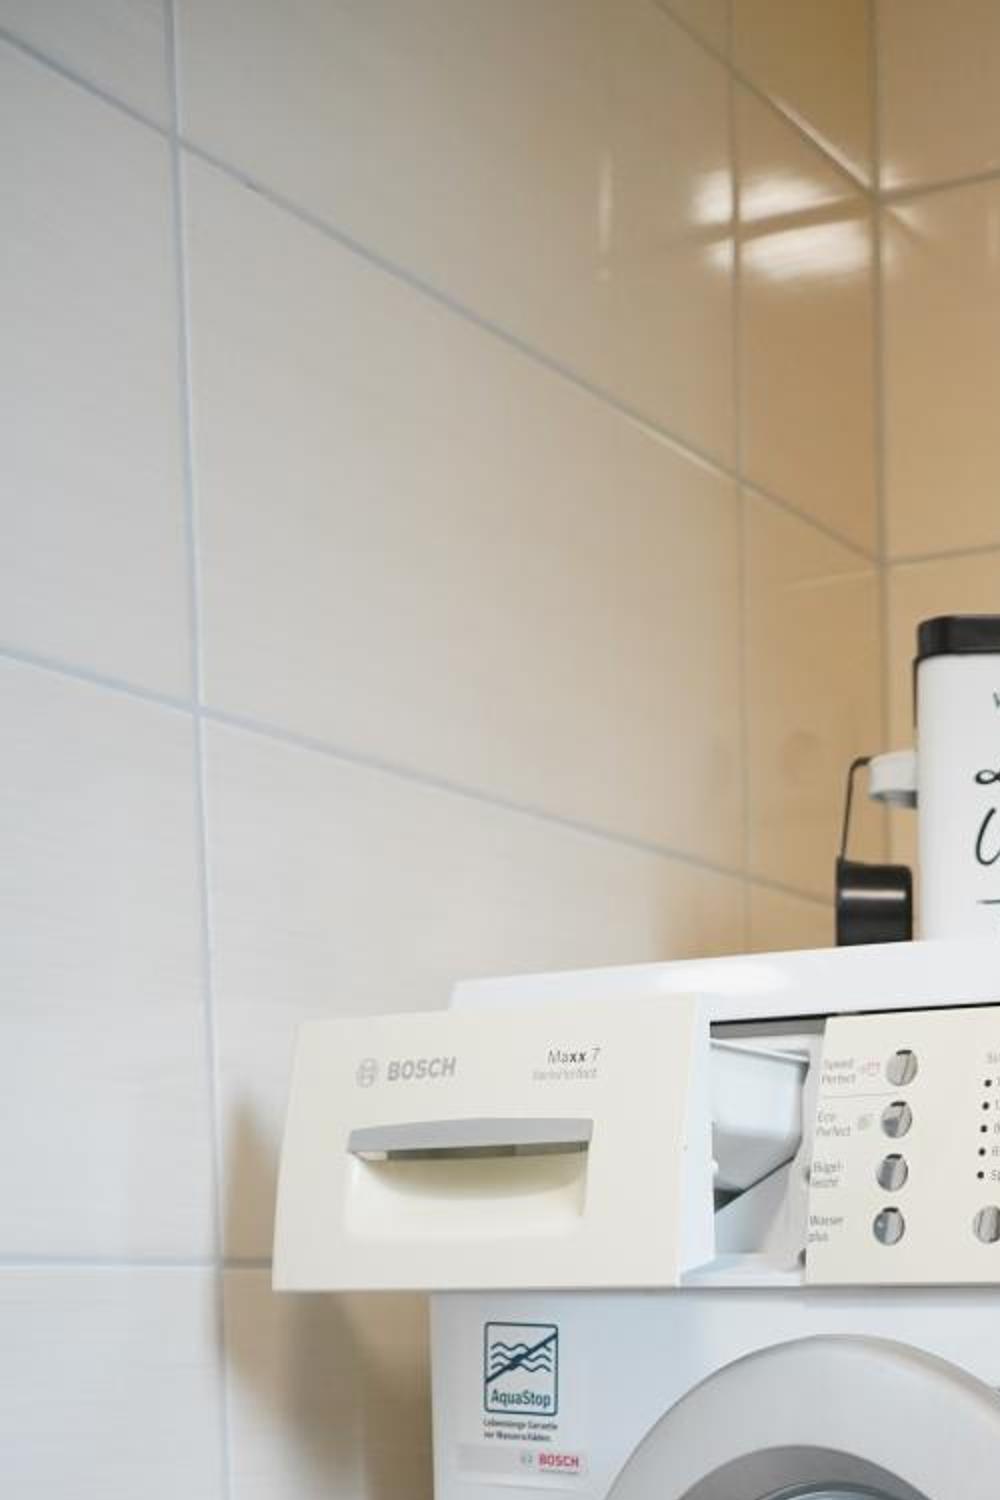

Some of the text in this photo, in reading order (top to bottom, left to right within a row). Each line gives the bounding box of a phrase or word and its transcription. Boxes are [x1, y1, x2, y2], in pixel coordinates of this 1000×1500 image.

[547, 1050, 586, 1064] Maxx
[387, 1056, 457, 1081] BOSCH
[491, 1389, 551, 1408] AquaStop
[539, 1452, 580, 1468] BOSCH
